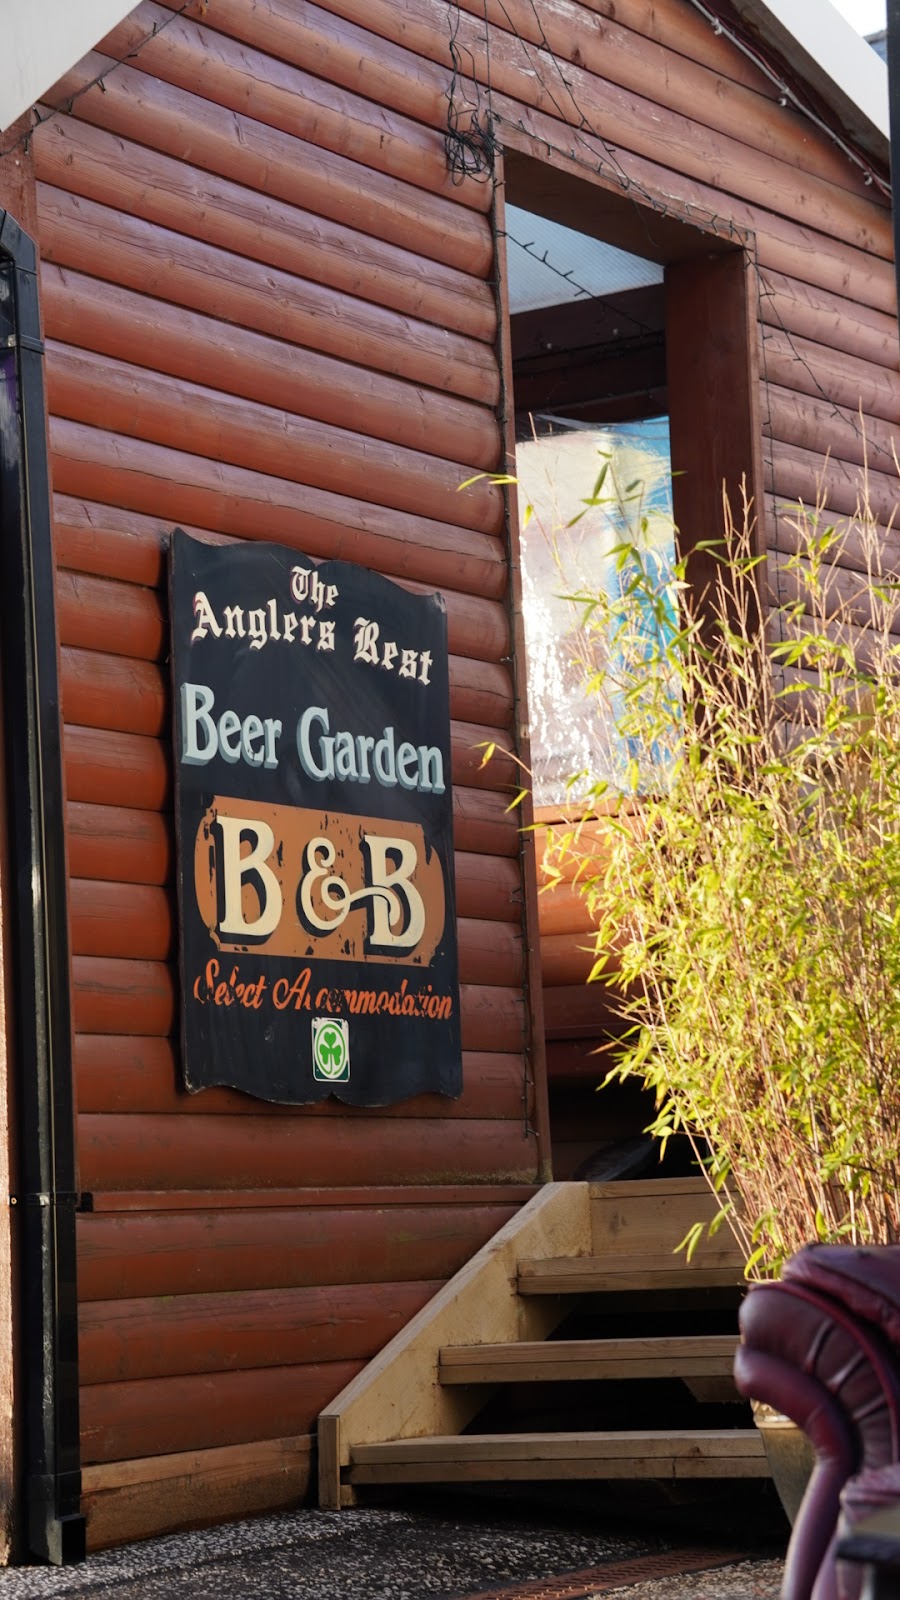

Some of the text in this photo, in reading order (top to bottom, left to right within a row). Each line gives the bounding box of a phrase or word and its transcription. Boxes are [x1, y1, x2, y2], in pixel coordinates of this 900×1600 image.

[290, 565, 339, 613] The
[191, 591, 433, 686] Anglers Rest
[180, 682, 446, 794] Beer Garden
[193, 958, 267, 1009] Select
